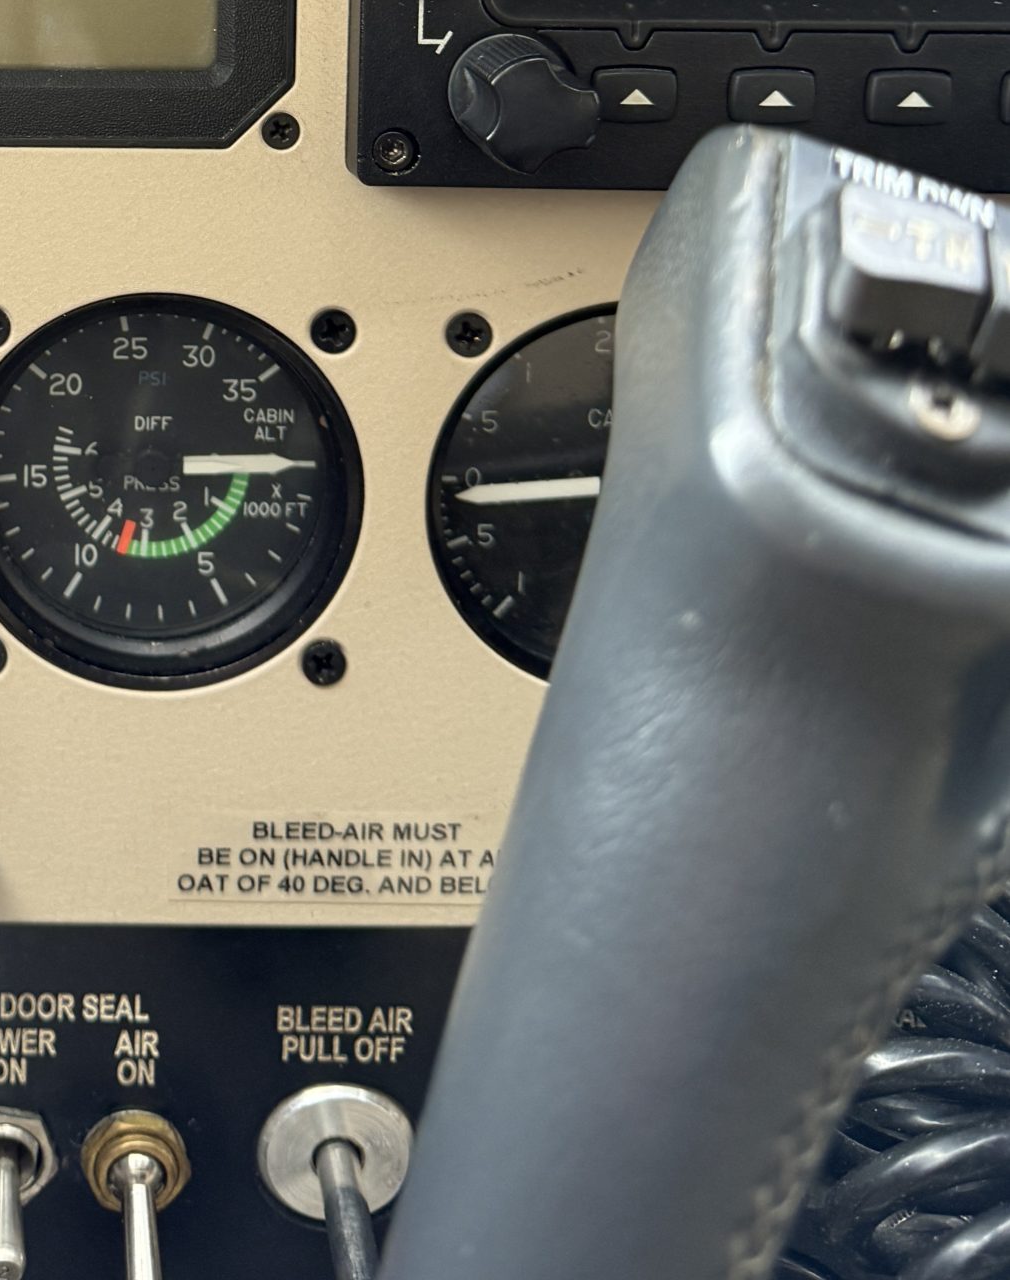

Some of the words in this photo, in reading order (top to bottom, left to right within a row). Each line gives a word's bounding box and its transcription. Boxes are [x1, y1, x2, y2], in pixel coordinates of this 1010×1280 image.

[834, 147, 914, 199] TRIM
[112, 336, 148, 360] 25
[182, 344, 216, 368] 30
[49, 372, 83, 396] 20
[139, 371, 167, 385] PSI
[222, 378, 257, 403] 35
[135, 416, 173, 431] DIFF
[243, 408, 295, 423] CABIN
[255, 426, 286, 440] ALT
[24, 464, 47, 487] 15
[271, 483, 282, 499] X
[107, 497, 123, 517] 4
[140, 508, 154, 528] 3
[173, 501, 188, 521] 2
[243, 501, 281, 517] 1000
[286, 502, 308, 517] FT
[75, 544, 98, 565] 10
[198, 552, 215, 575] 5
[252, 821, 384, 841] BLEED-AIR
[392, 823, 462, 842] MUST
[197, 847, 231, 867] BE
[238, 848, 276, 867] ON
[283, 848, 392, 871] (HANDLE
[400, 849, 433, 872] IN)
[439, 849, 472, 868] AT
[479, 849, 501, 868] A
[177, 873, 229, 893] OAT
[236, 874, 271, 894] OF
[277, 875, 306, 894] 40
[313, 875, 371, 894] DEG.
[377, 876, 432, 895] AND
[440, 876, 491, 894] BEL
[0, 993, 76, 1021] DOOR
[82, 994, 150, 1022] SEAL
[277, 1005, 363, 1034] BLEED
[368, 1007, 413, 1034] AIR
[114, 1030, 160, 1058] AIR
[281, 1035, 348, 1063] PULL
[354, 1036, 406, 1063] OFF
[117, 1058, 155, 1086] ON
